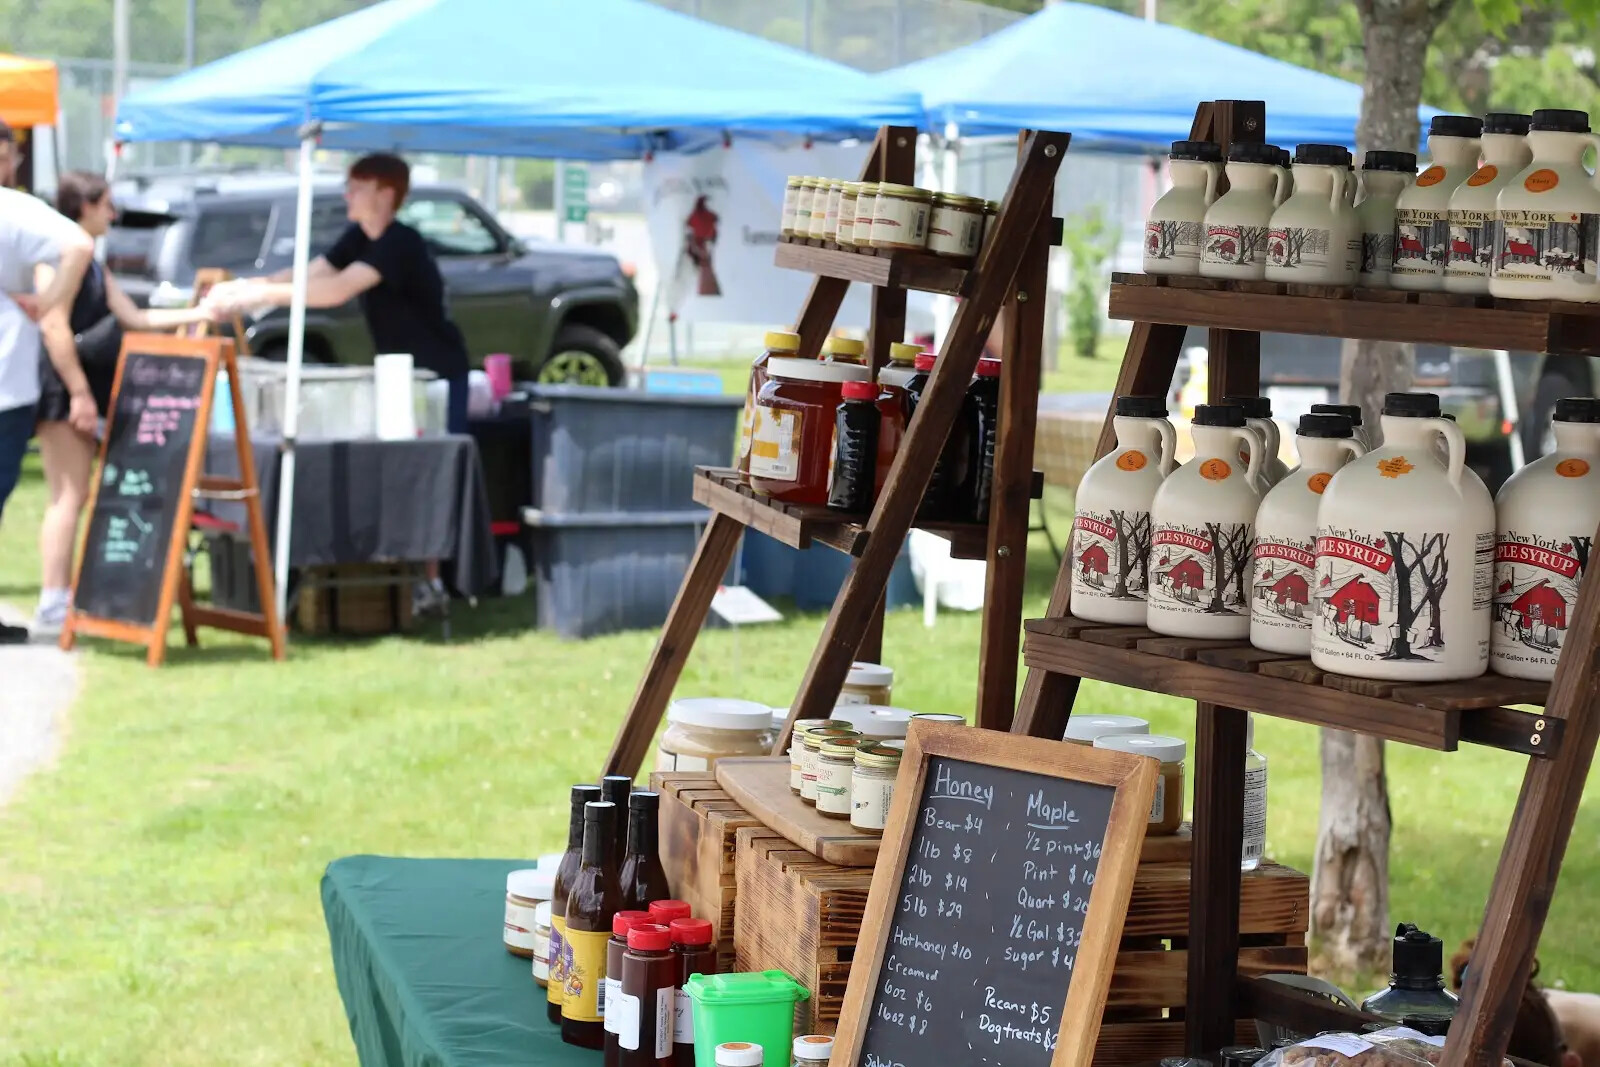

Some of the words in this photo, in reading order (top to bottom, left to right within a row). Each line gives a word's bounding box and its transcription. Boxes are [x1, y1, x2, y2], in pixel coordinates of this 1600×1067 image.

[1412, 208, 1440, 219] YORK
[1462, 209, 1490, 220] YORK
[1501, 210, 1518, 220] NEW
[1522, 210, 1556, 221] YORK
[1090, 510, 1105, 522] York
[1084, 519, 1113, 537] SYRUP
[1166, 521, 1181, 531] New
[1182, 524, 1200, 536] York
[1328, 525, 1347, 538] New
[1349, 528, 1373, 547] York
[1173, 532, 1209, 550] SYRUP
[1269, 534, 1284, 544] New
[1286, 537, 1305, 550] York
[1508, 530, 1530, 543] New
[1532, 533, 1559, 552] York
[1277, 546, 1313, 564] SYRUP
[1337, 540, 1388, 567] SYRUP
[1520, 546, 1574, 571] SYRUP
[1325, 647, 1341, 657] Gallon
[1345, 651, 1353, 659] 64
[1354, 652, 1362, 660] Fl.
[1364, 653, 1376, 661] Oz.
[1506, 653, 1524, 662] Gallon
[1530, 656, 1538, 664] 64
[1540, 657, 1549, 665] Fl.
[934, 763, 994, 810] Honey
[1026, 789, 1080, 824] Maple
[924, 806, 961, 831] Bear
[964, 813, 983, 834] $4
[919, 835, 941, 858] 1lb
[952, 843, 973, 863] $8
[1083, 840, 1101, 861] $6
[908, 863, 932, 887] 2lb
[944, 872, 968, 893] $19
[1023, 860, 1058, 880] Pint
[902, 893, 927, 918] 5lb
[937, 898, 962, 919] $29
[1017, 886, 1056, 909] Quart
[1027, 919, 1053, 942] Gal.
[951, 941, 972, 960] $10
[1003, 946, 1045, 971] Sugar
[887, 954, 939, 981] Creamed
[984, 985, 1027, 1015] Pecans
[1030, 1001, 1052, 1025] $5
